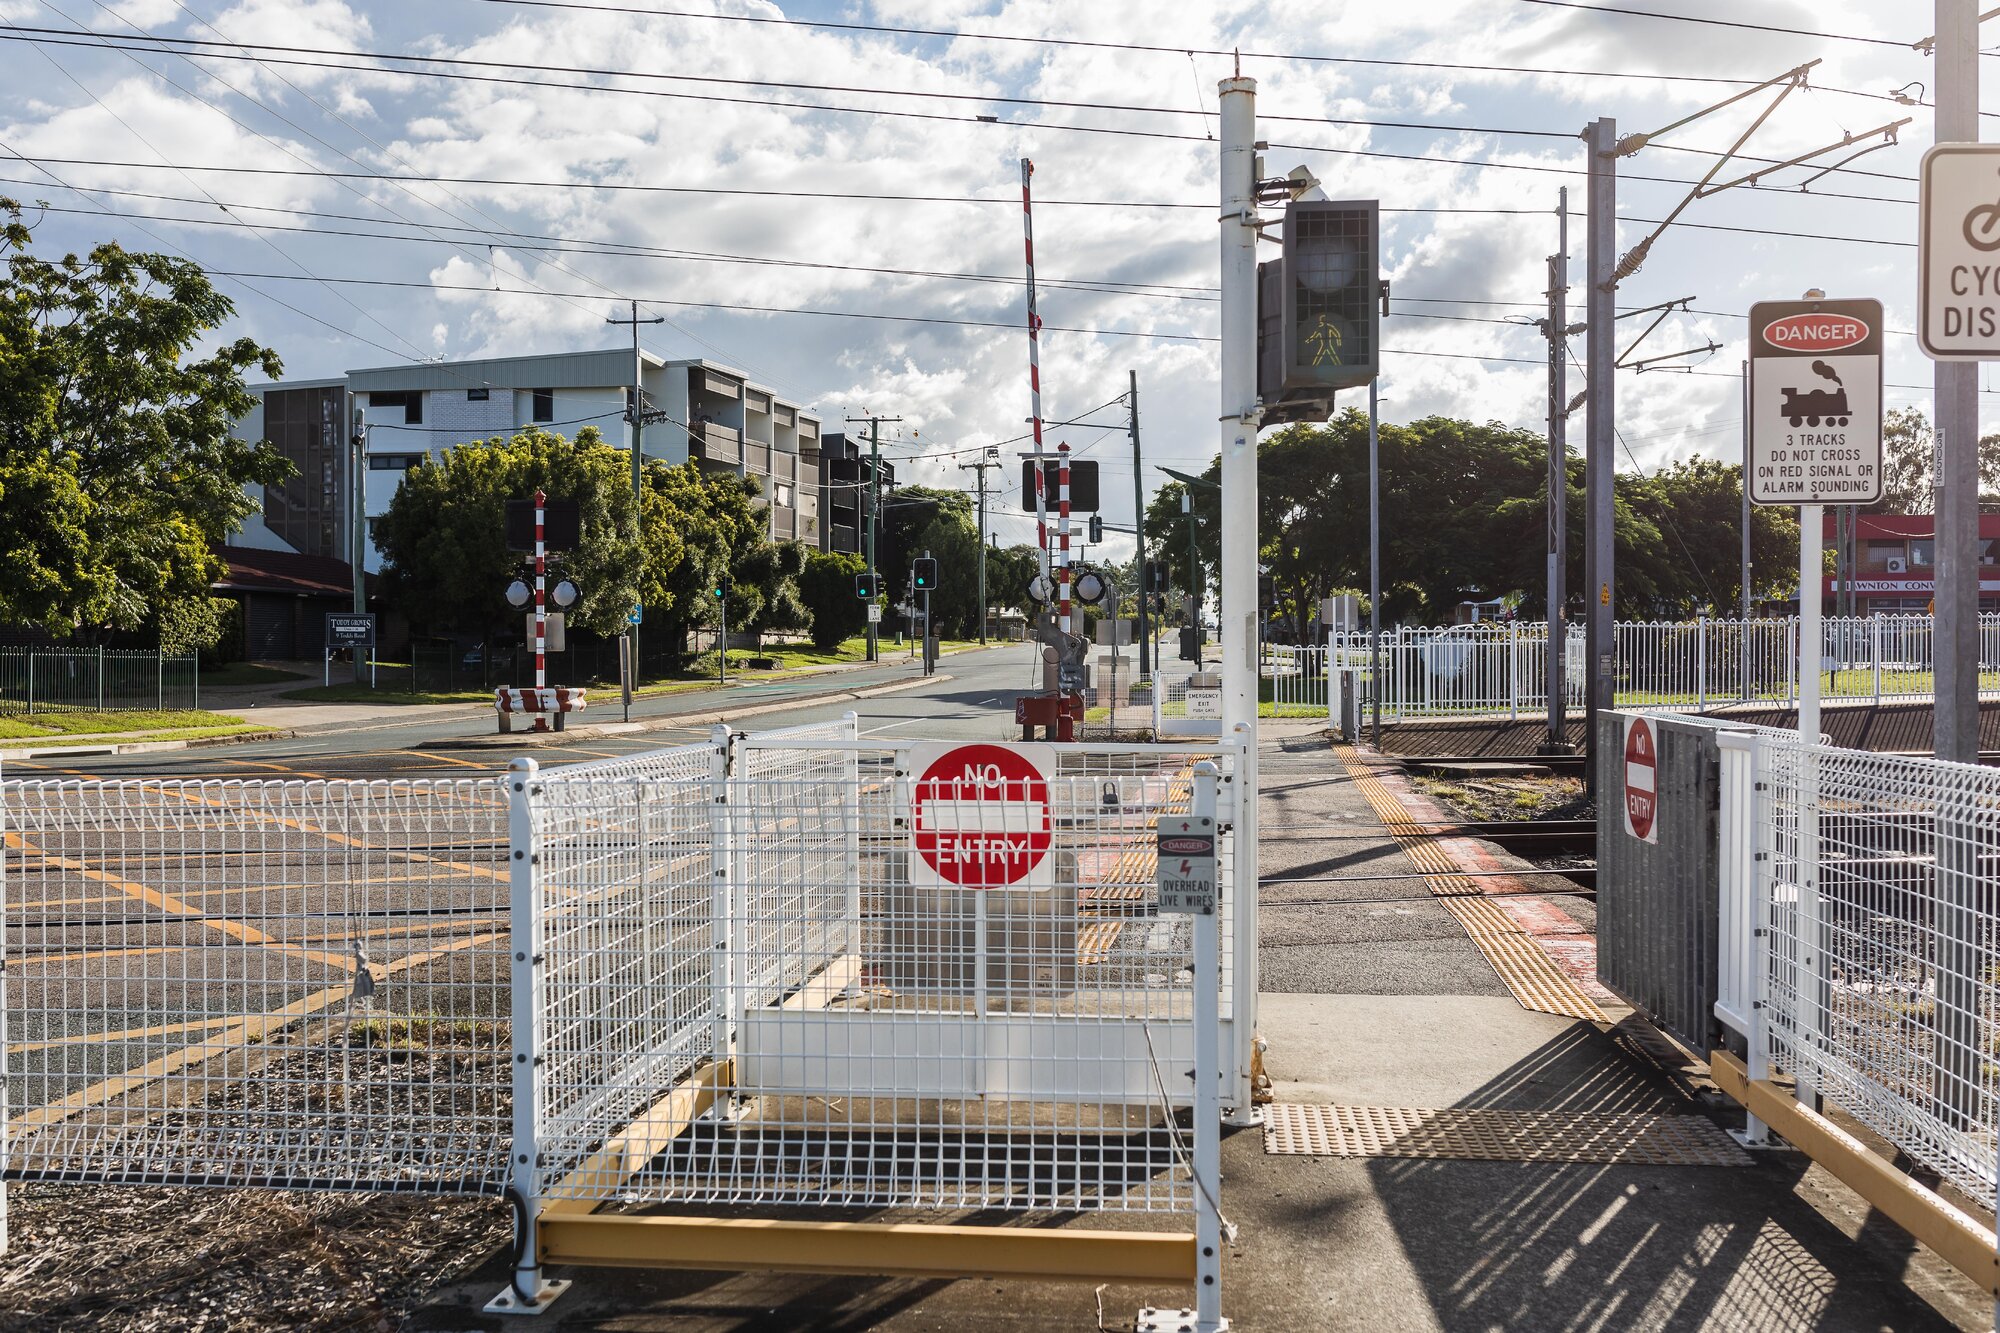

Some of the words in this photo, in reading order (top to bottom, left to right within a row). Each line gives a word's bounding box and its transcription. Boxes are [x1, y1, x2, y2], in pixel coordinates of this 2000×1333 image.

[1944, 306, 1996, 338] DIS
[1775, 323, 1857, 341] DANGER
[1786, 434, 1794, 446] 3
[1800, 433, 1846, 446] TRACKS
[1771, 450, 1787, 462] DO
[1793, 449, 1815, 461] NOT
[1821, 448, 1861, 461] CROSS
[1758, 466, 1774, 478] ON
[1780, 465, 1803, 477] RED
[1809, 465, 1852, 477] SIGNAL
[1858, 464, 1873, 476] OR
[1762, 481, 1804, 493] ALARM
[1810, 480, 1869, 493] SOUNDING
[1635, 733, 1646, 755] NO
[964, 763, 1001, 789] NO
[1630, 794, 1651, 820] ENTRY
[937, 838, 1027, 865] ENTRY
[1168, 841, 1203, 849] DANGER
[1163, 879, 1210, 892] OVERHEAD
[1160, 895, 1179, 907] LIVE
[1185, 895, 1214, 907] WIRES
